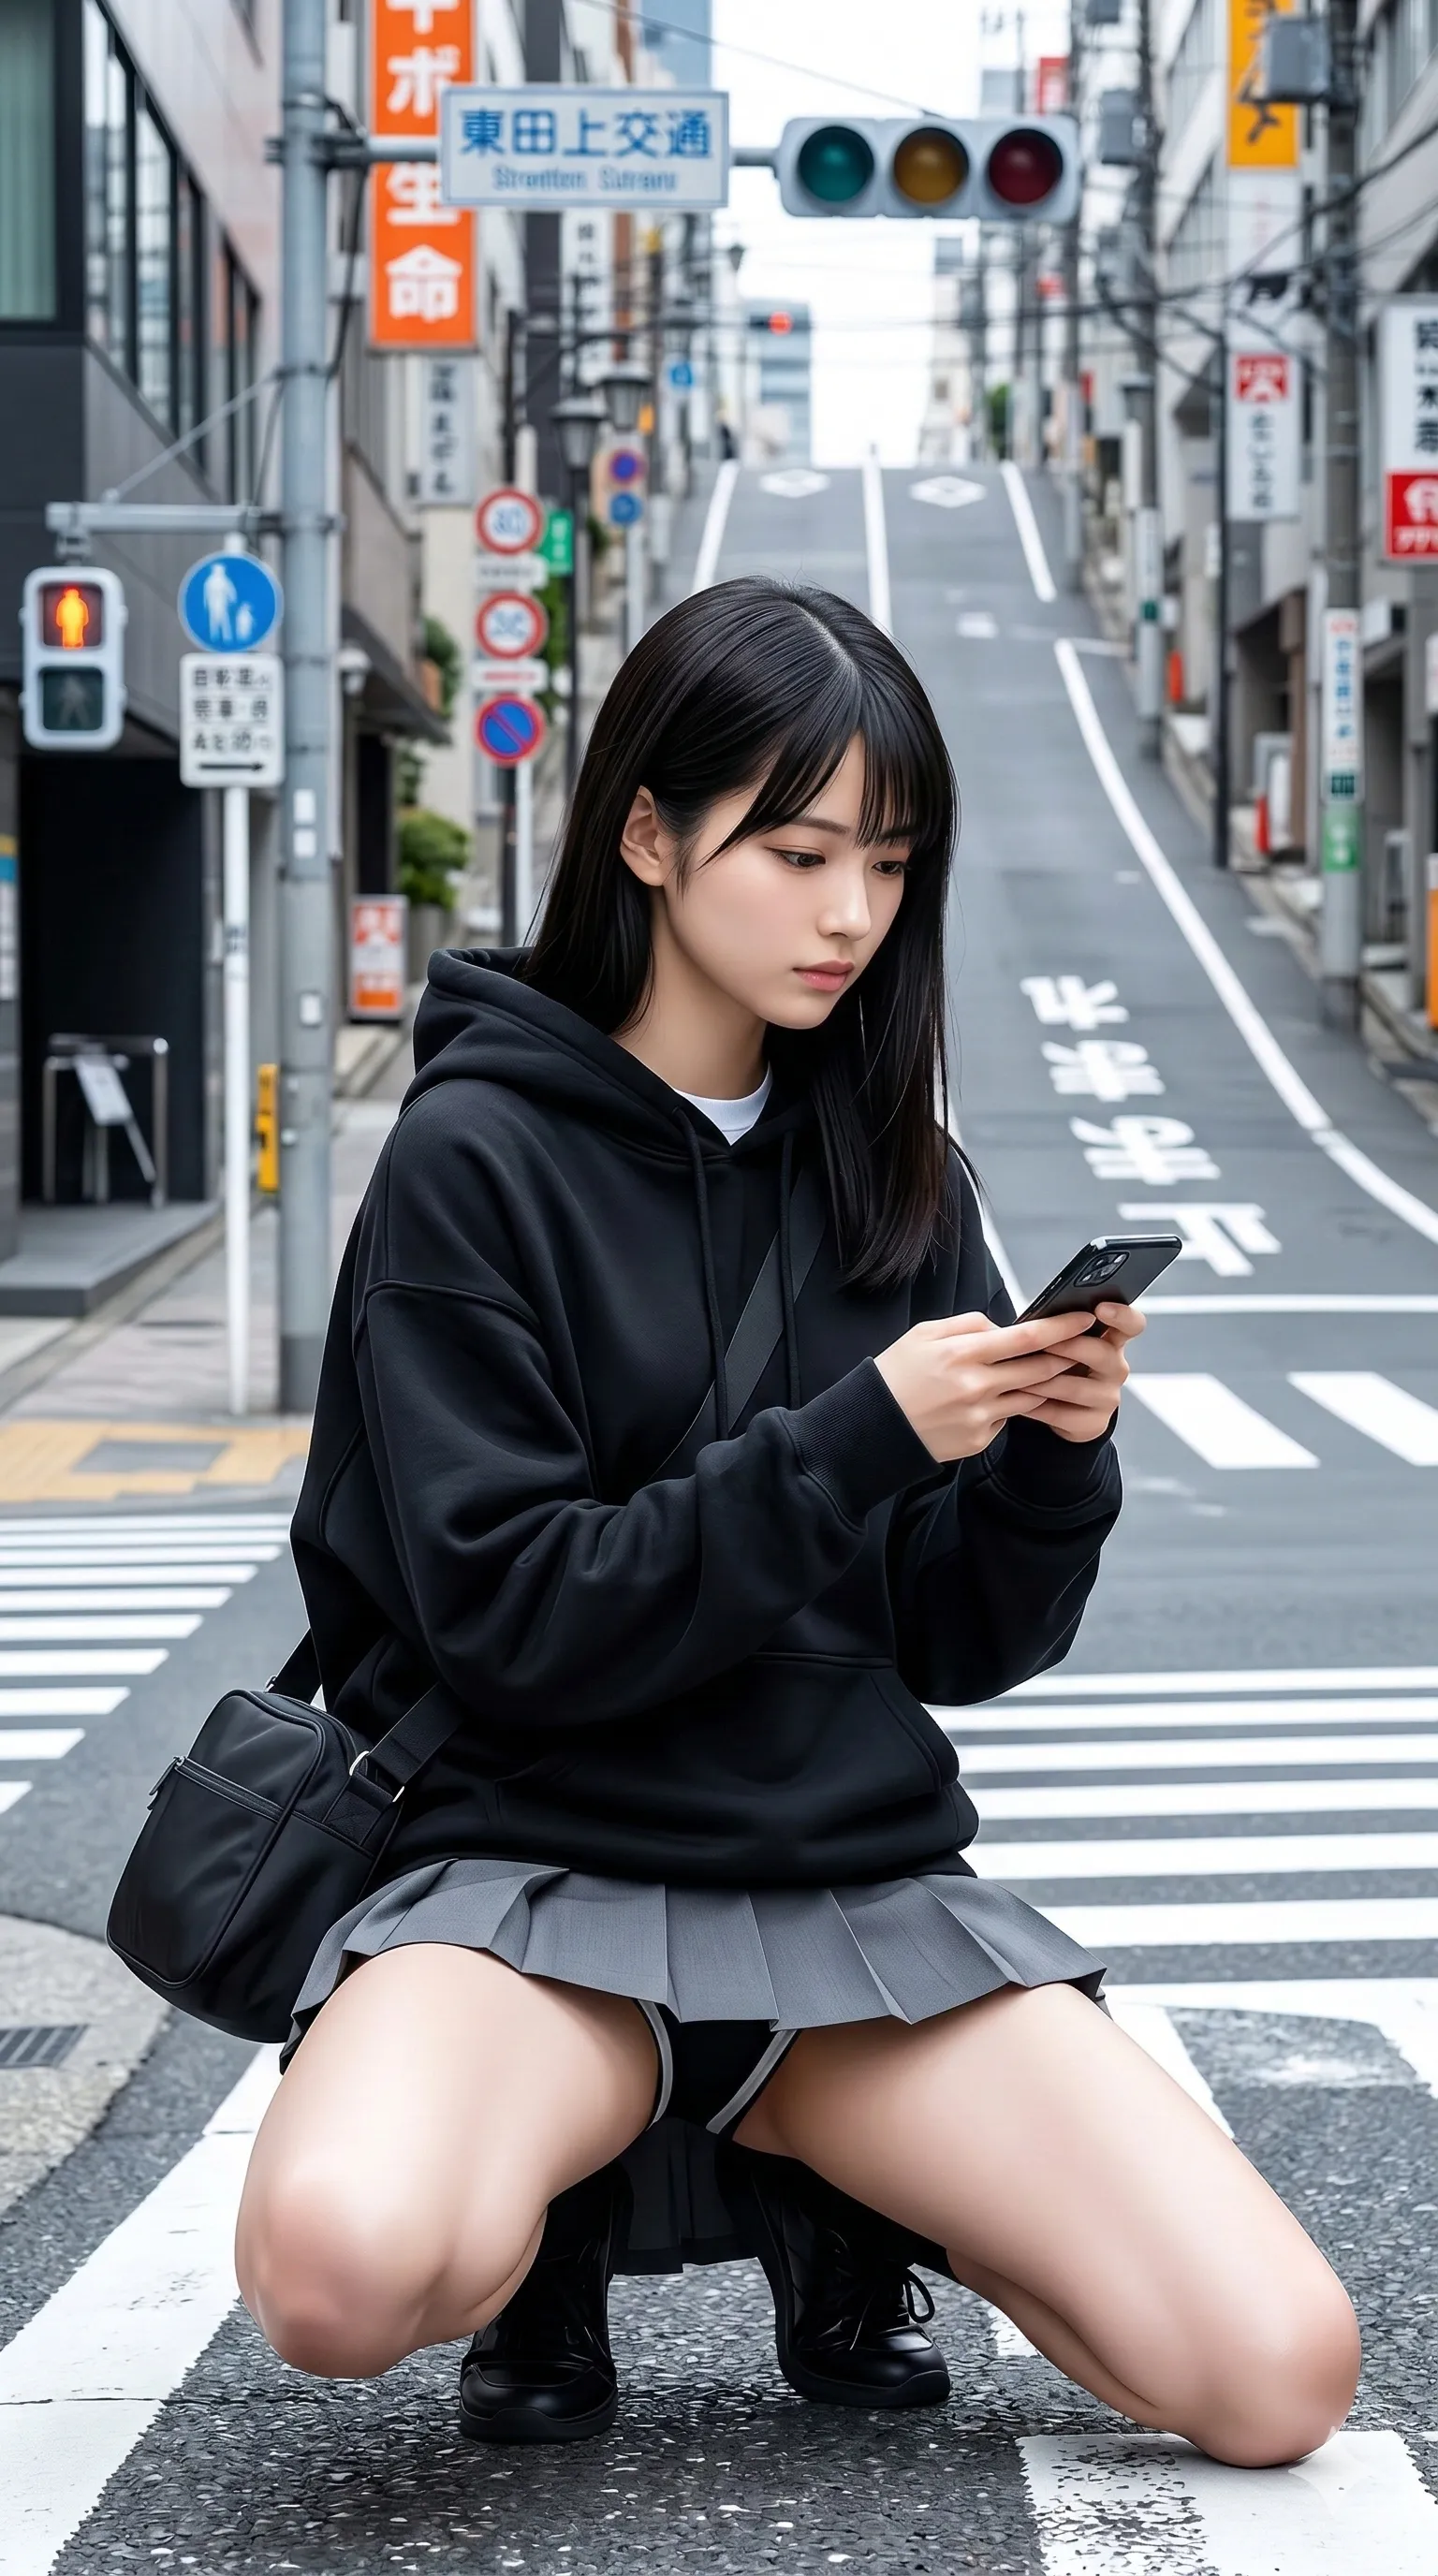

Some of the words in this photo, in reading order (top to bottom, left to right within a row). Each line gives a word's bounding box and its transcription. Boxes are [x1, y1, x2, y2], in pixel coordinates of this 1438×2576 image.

[460, 107, 713, 158] 東田上交通
